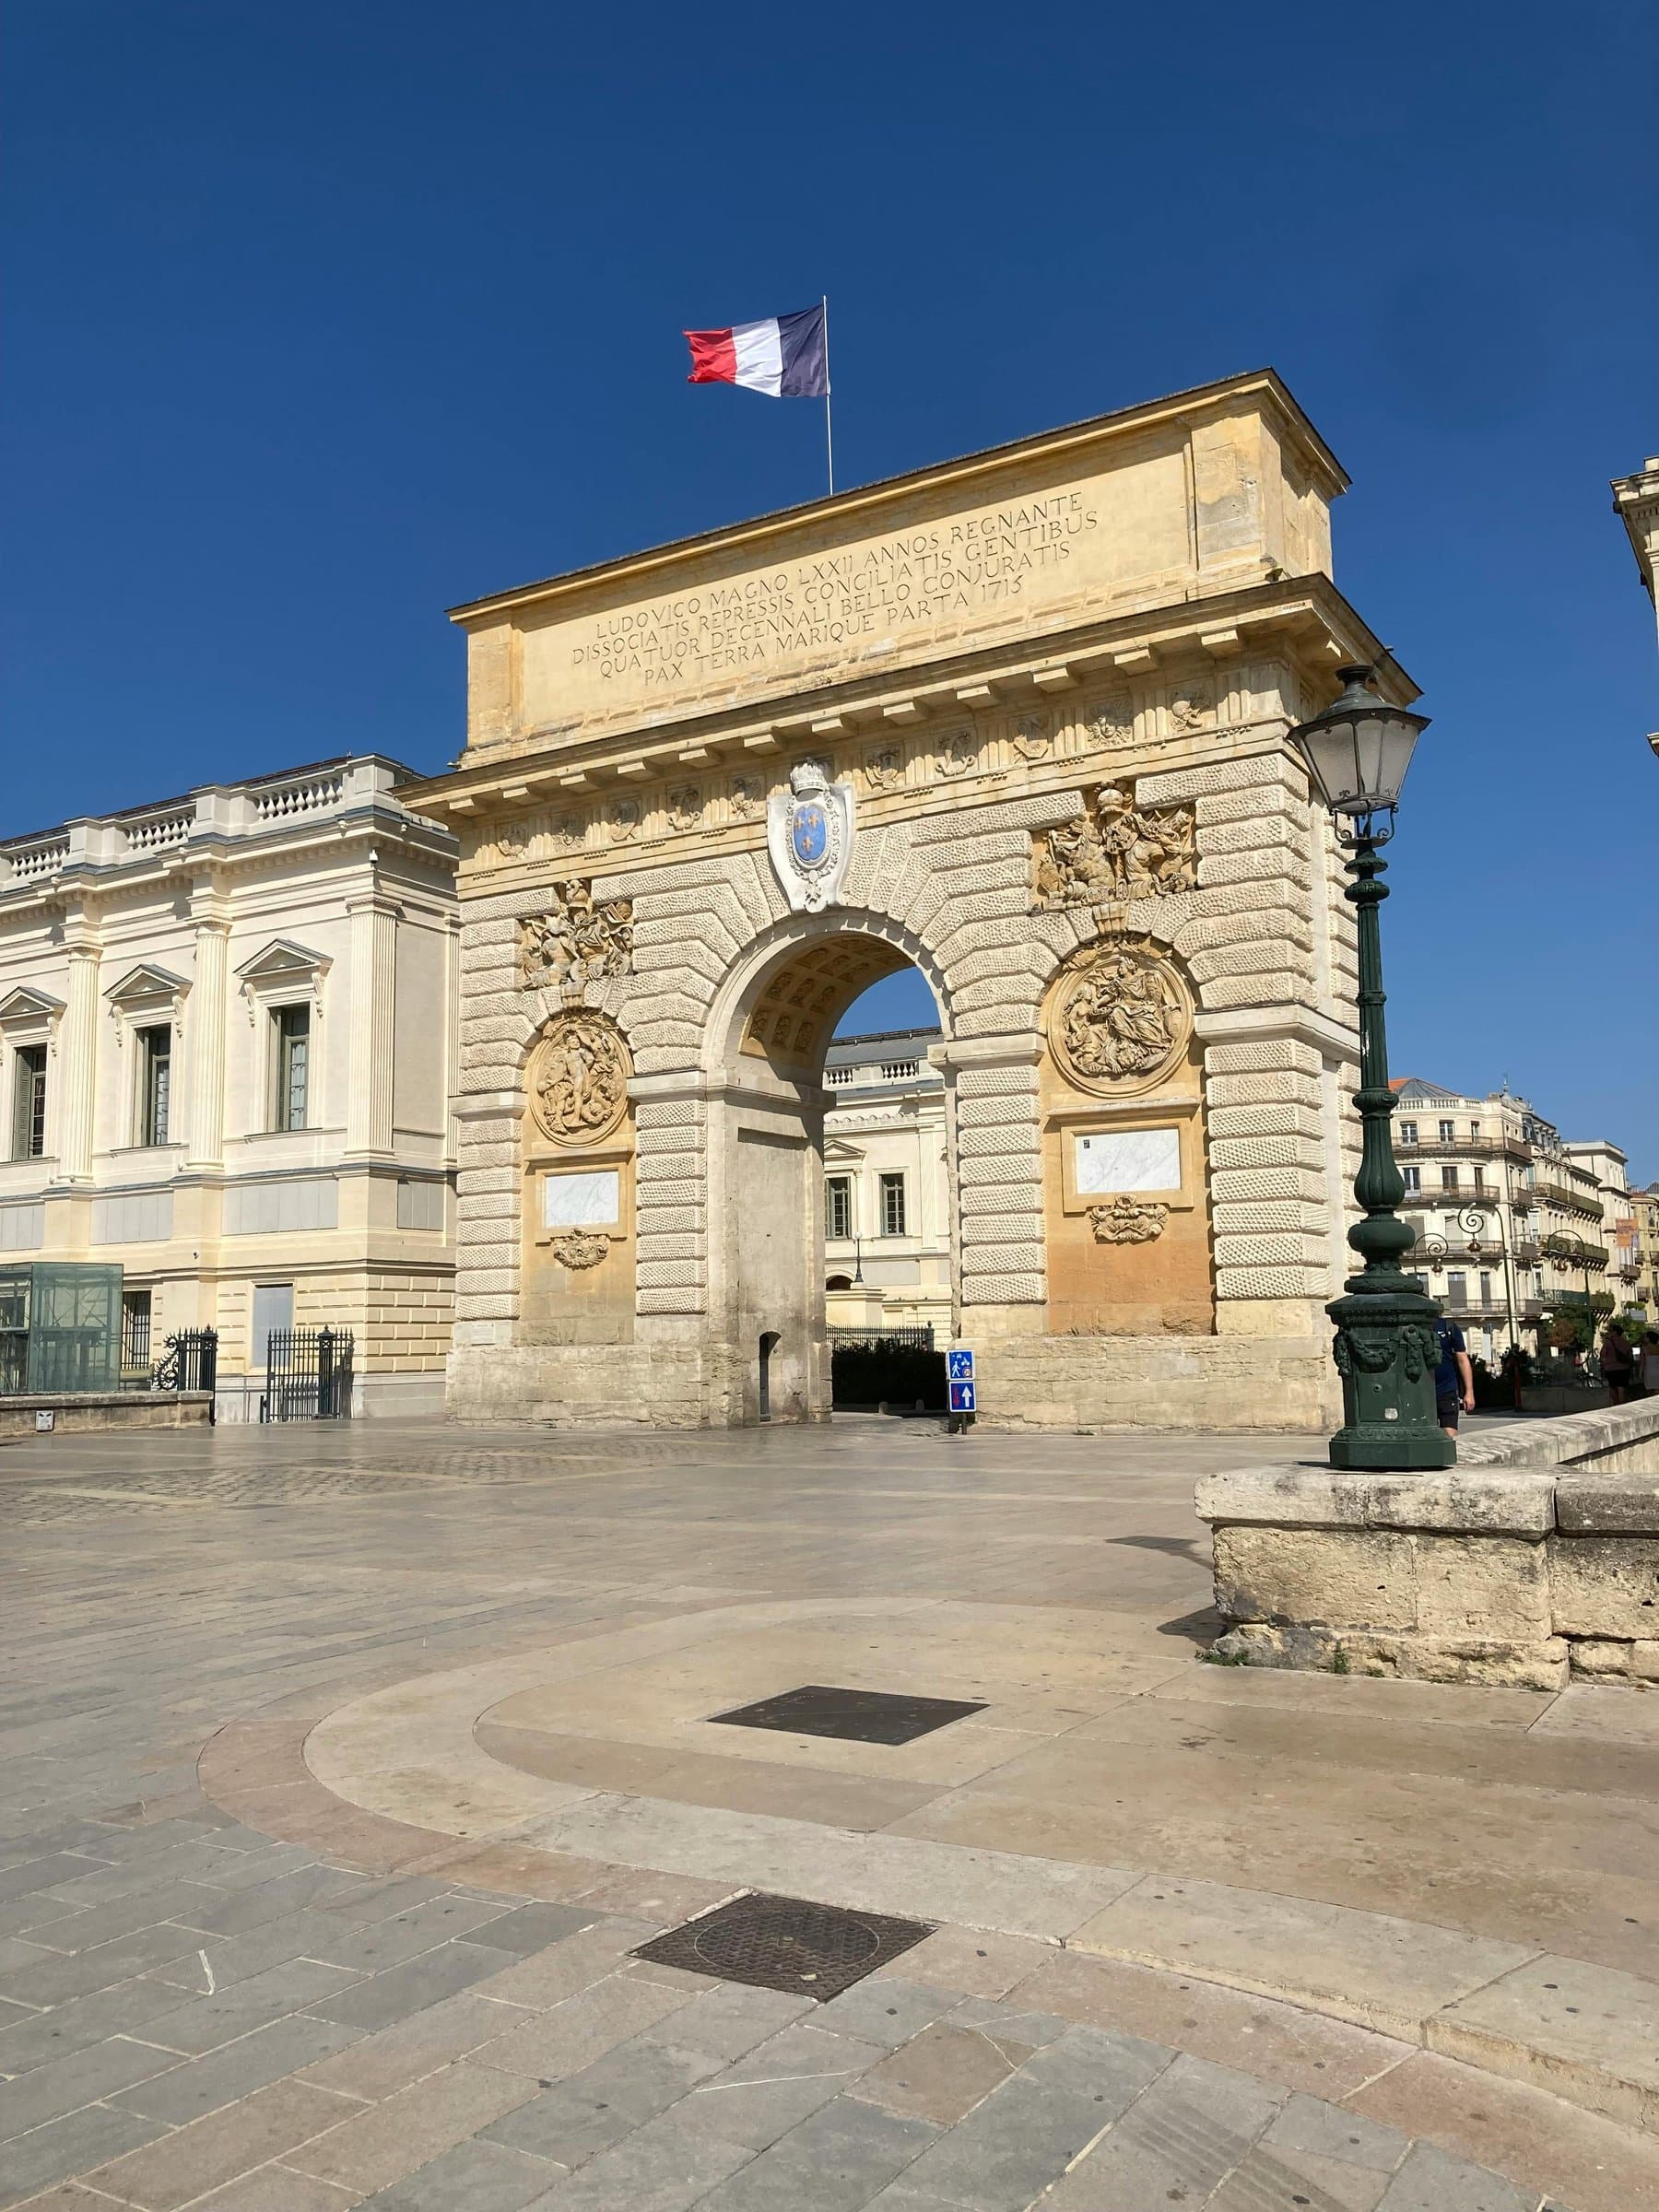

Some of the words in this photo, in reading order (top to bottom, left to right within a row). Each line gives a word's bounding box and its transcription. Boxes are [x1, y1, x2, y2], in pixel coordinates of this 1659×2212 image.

[572, 619, 689, 665] DISSOCIATIS
[699, 593, 794, 632] REPRESSIS
[805, 550, 952, 604] CONCILIATIS
[965, 511, 1098, 561] GENTIBUS
[597, 598, 700, 639] LUDOVICO
[711, 574, 788, 609] MAGNO
[798, 555, 853, 584] LXXII
[864, 532, 939, 569] ANNOS
[950, 491, 1083, 545] REGNANTE
[600, 638, 700, 678] QUATUOR
[712, 604, 831, 649] DECENNALI
[841, 583, 911, 617] BELLO
[923, 540, 1070, 594] CONJURATIS
[644, 661, 684, 686] PAX
[694, 642, 765, 673] TERRA
[775, 613, 875, 654] MARIQUE
[887, 591, 969, 627] PARTA
[982, 574, 1025, 602] 1715
